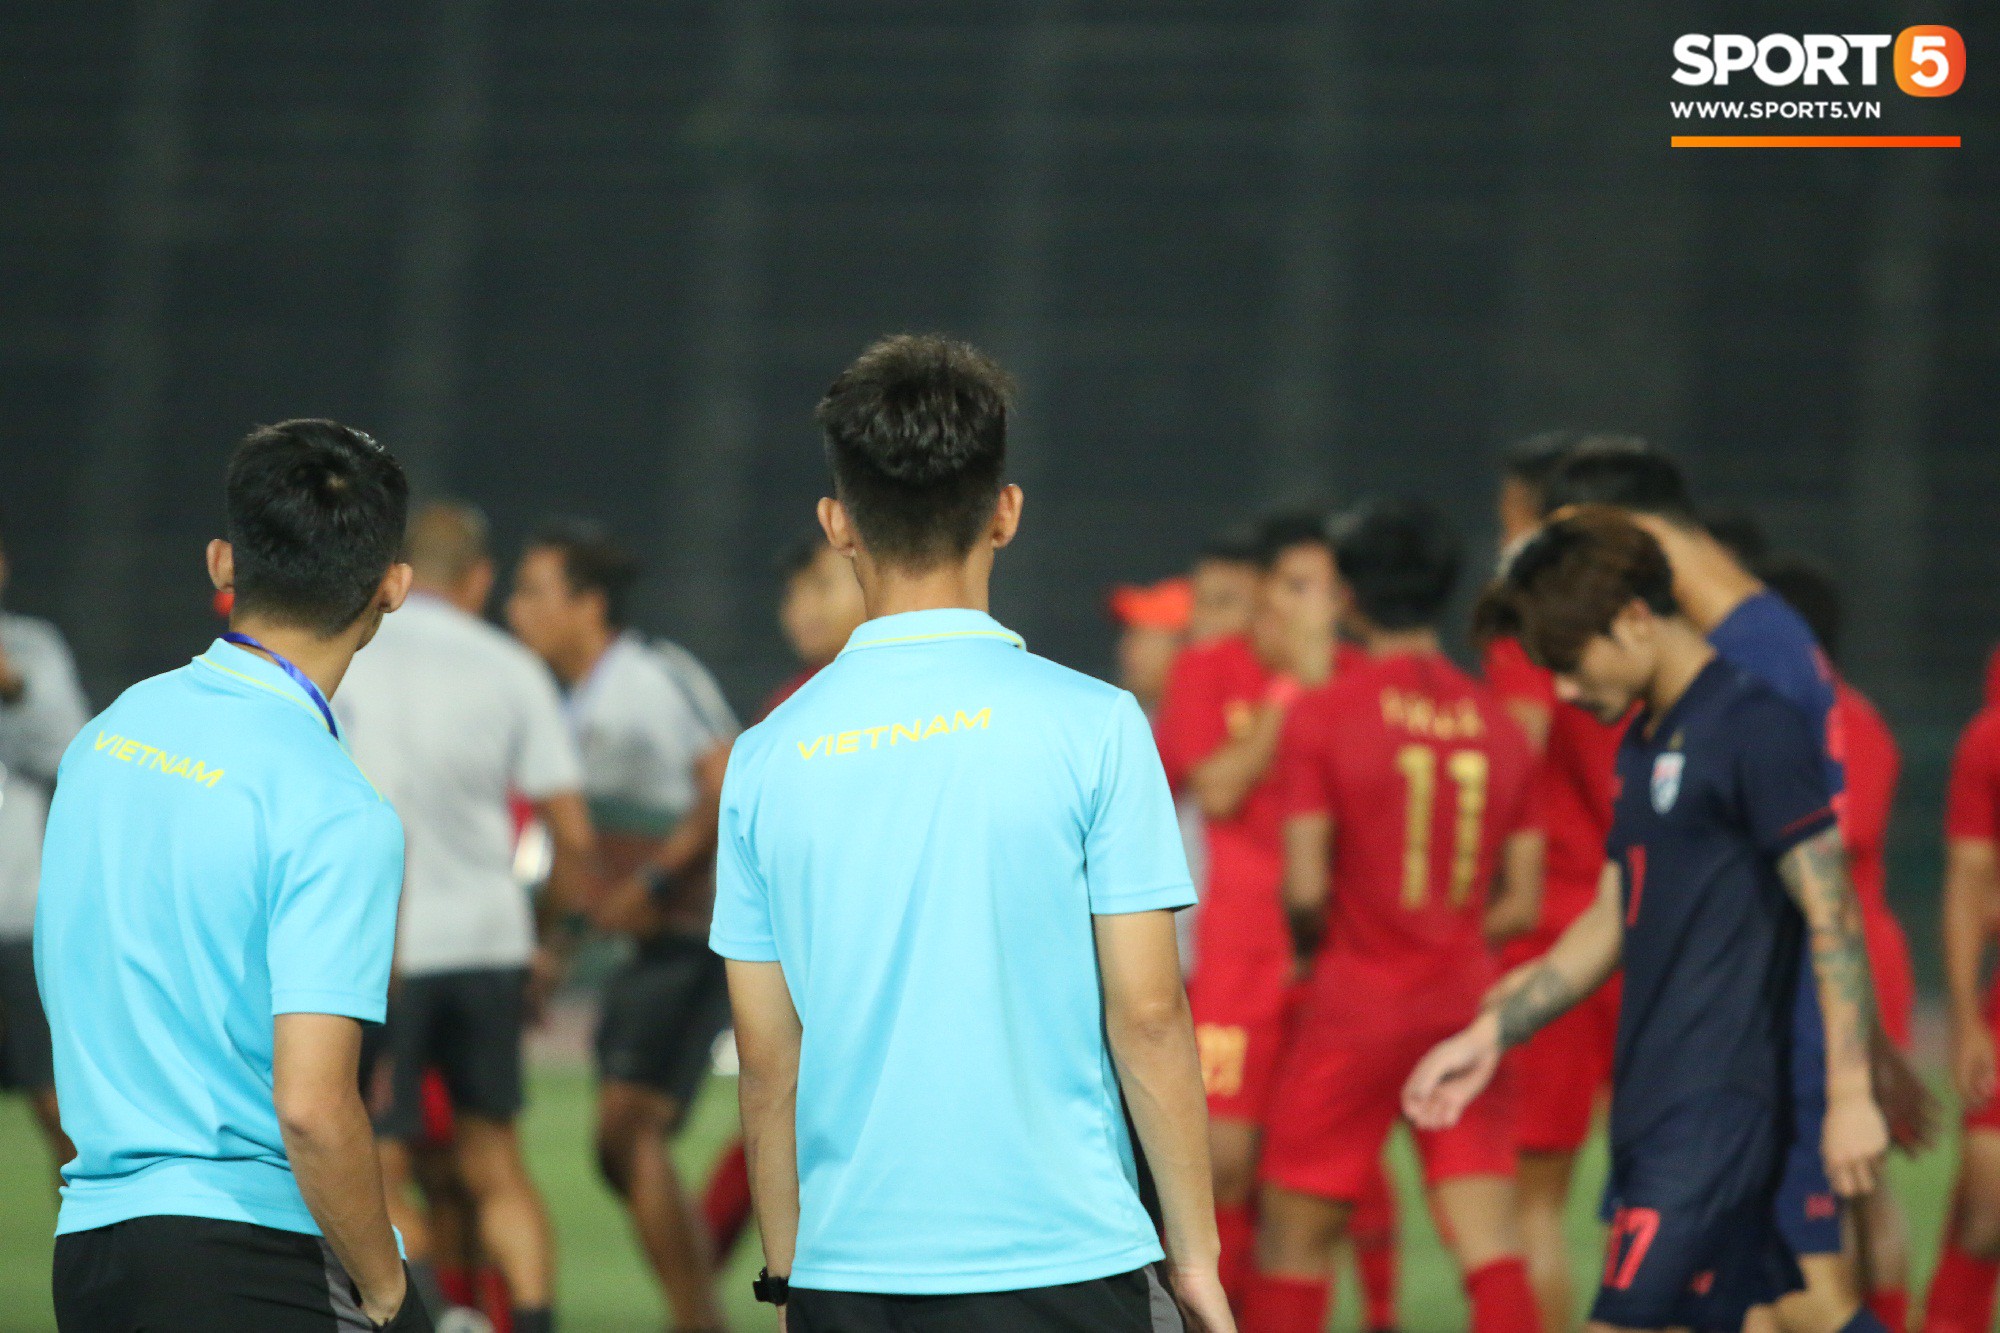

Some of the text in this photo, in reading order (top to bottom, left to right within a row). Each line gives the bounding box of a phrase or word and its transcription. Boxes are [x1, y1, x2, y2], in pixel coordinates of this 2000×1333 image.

[95, 730, 224, 788] VIETNAM
[797, 707, 992, 760] VIETNAM
[1395, 744, 1489, 910] 11
